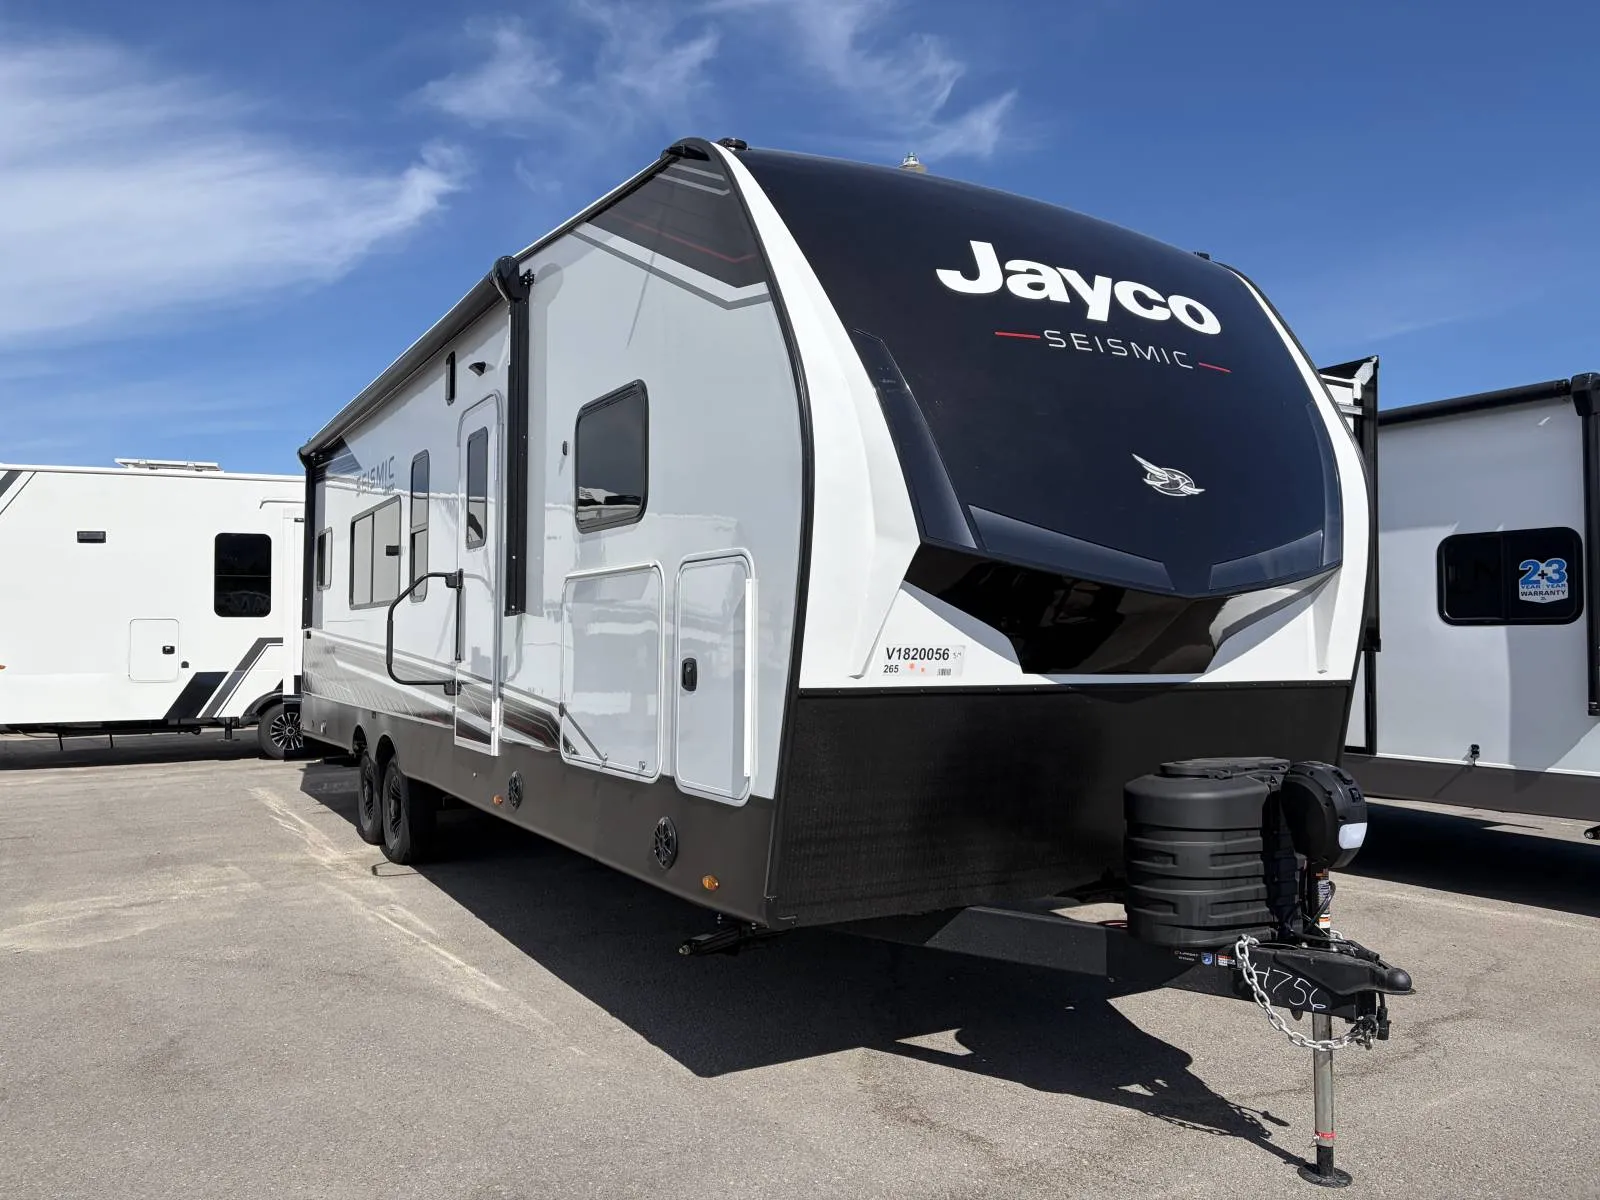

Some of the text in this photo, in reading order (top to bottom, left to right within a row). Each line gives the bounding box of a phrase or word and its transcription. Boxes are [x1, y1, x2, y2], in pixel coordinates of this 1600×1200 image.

[936, 240, 1221, 335] Jayco
[1044, 330, 1194, 369] SEISMIC
[1519, 558, 1567, 585] 2+3
[886, 647, 950, 661] V1820056
[883, 664, 899, 674] 265
